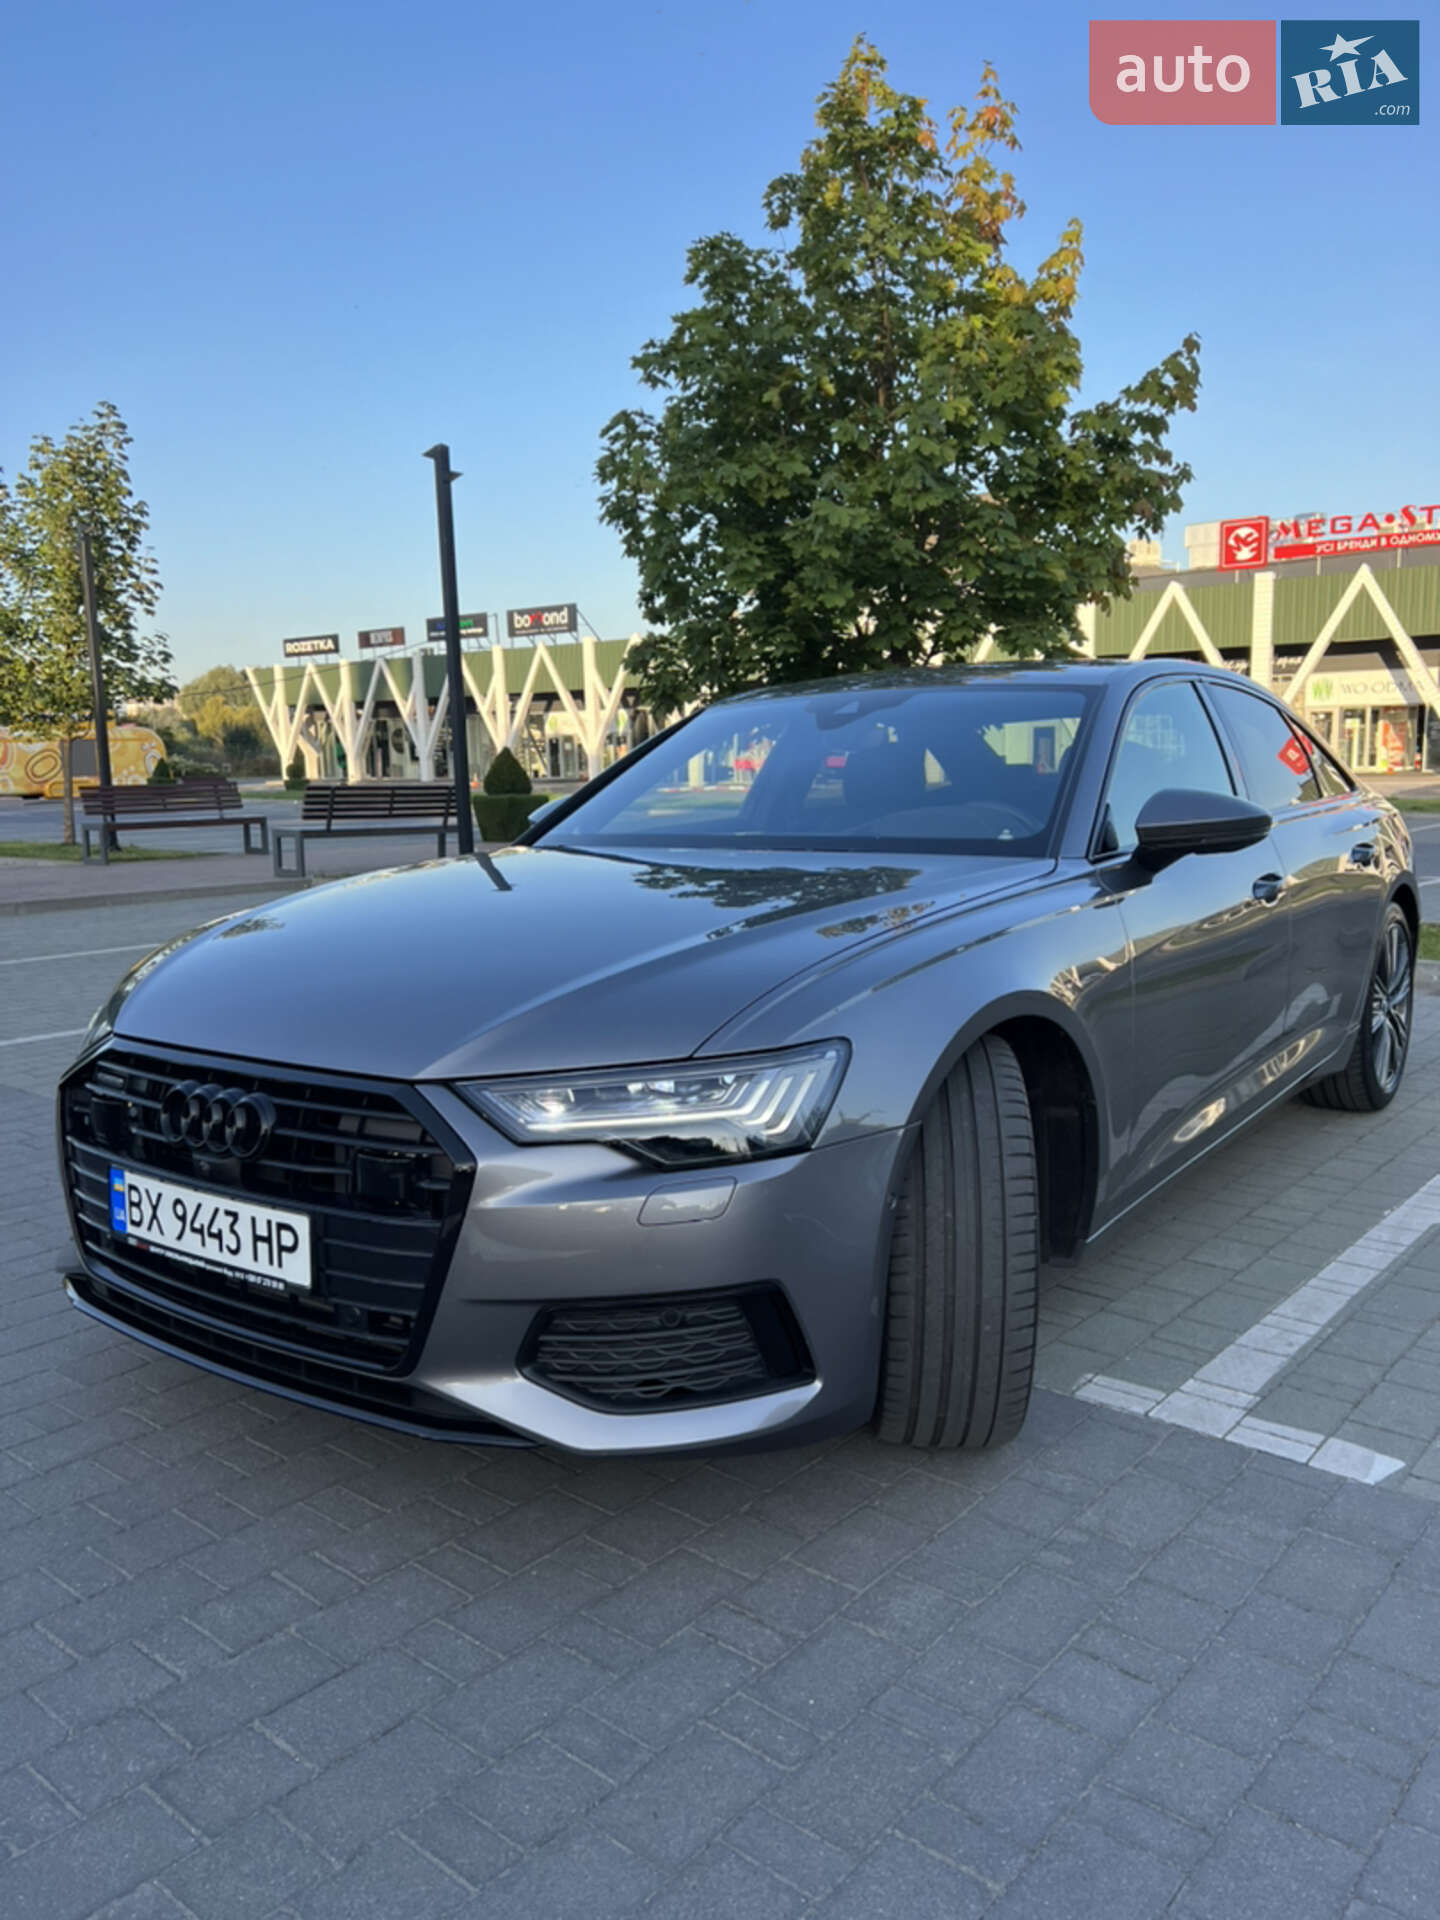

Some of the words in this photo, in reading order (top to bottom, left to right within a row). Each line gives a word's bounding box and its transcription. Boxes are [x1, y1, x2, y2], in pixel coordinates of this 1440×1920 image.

[1336, 537, 1378, 551] БРЕНДИ
[285, 638, 335, 655] ROZETKA
[128, 1183, 164, 1237] BX
[172, 1197, 241, 1256] 9443
[251, 1216, 299, 1269] HP
